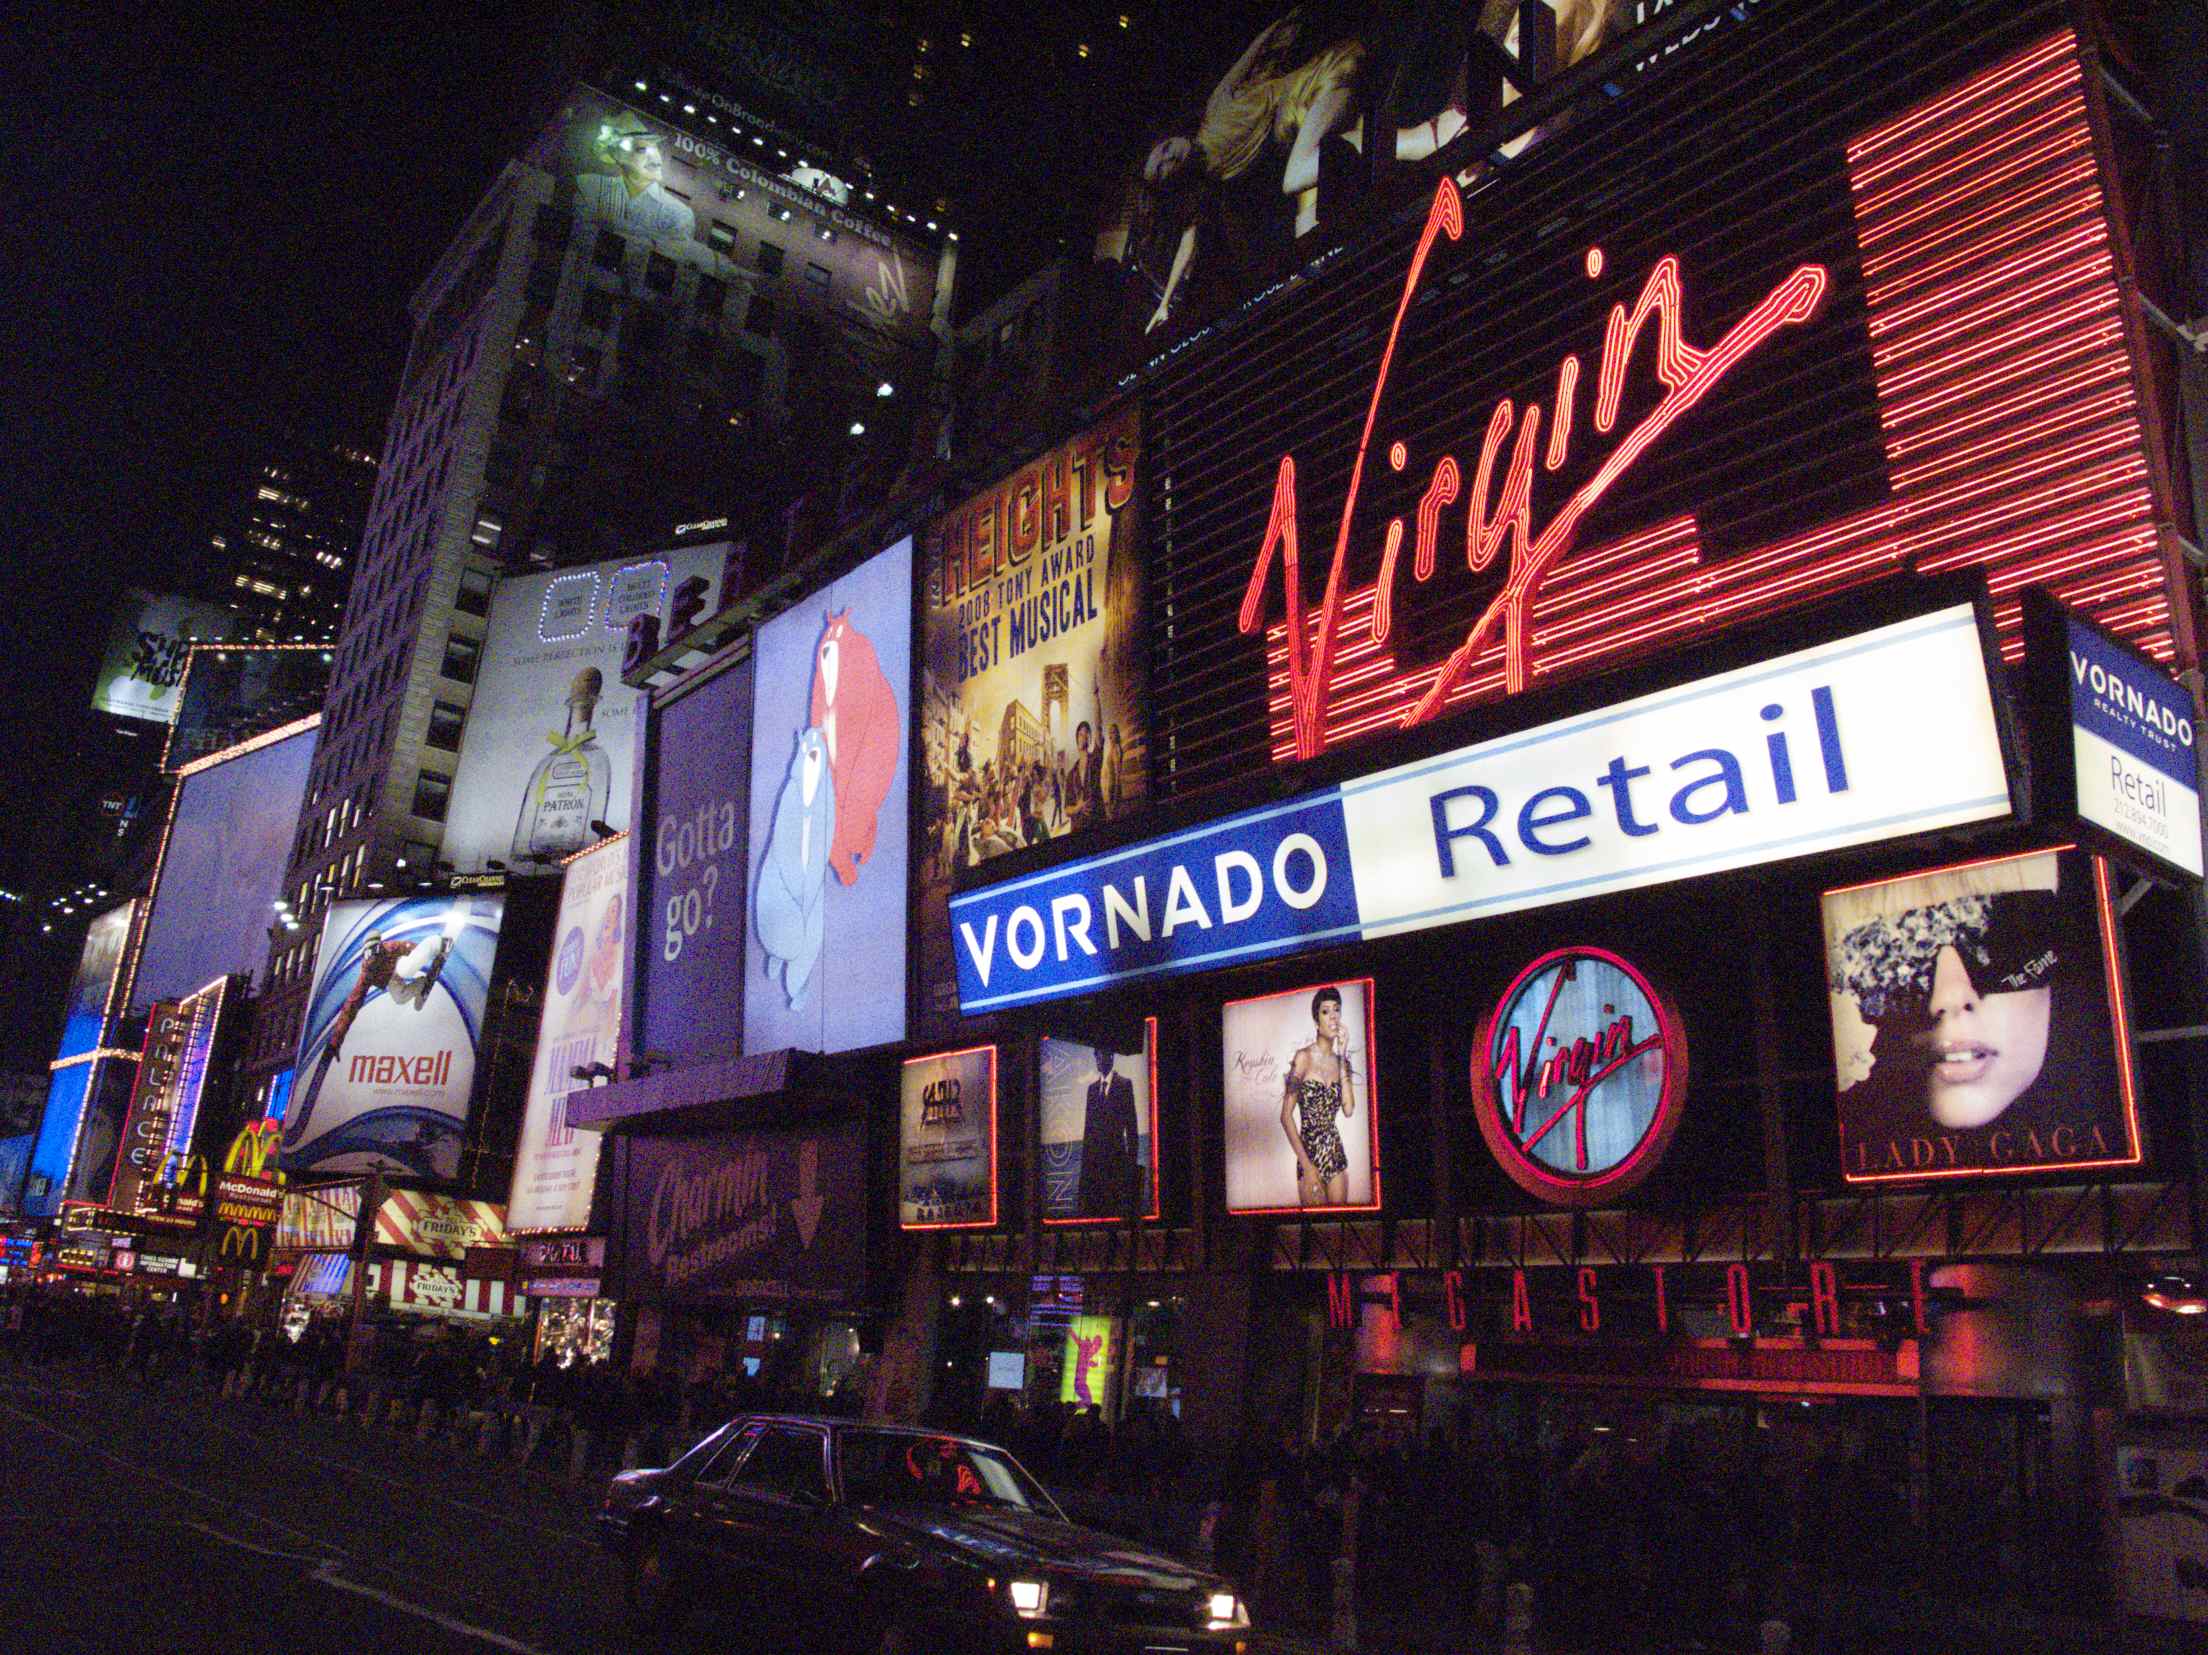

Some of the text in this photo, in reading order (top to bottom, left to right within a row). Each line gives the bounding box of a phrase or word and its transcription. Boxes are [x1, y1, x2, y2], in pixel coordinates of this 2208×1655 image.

[673, 132, 721, 166] 100%
[725, 156, 826, 217] Colombian
[1239, 176, 1828, 760] Virgin
[942, 436, 1139, 606] HEIGHTS
[957, 533, 1095, 629] 2008 TONY AWARD
[957, 565, 1098, 685] BEST MUSICAL
[2069, 651, 2194, 747] VORNADO
[2093, 697, 2177, 753] REALTY TRUST
[1429, 685, 1849, 878] Retail
[2110, 755, 2168, 818] Retail
[656, 801, 735, 877] Gotta
[664, 865, 718, 961] go?
[961, 832, 1328, 988] VORNADO
[2001, 950, 2058, 988] The Fame
[348, 1050, 453, 1086] maxell
[1494, 958, 1665, 1170] Virgin
[1857, 1122, 2110, 1170] LADY GAGA
[422, 1219, 477, 1239] FRIDAY'S
